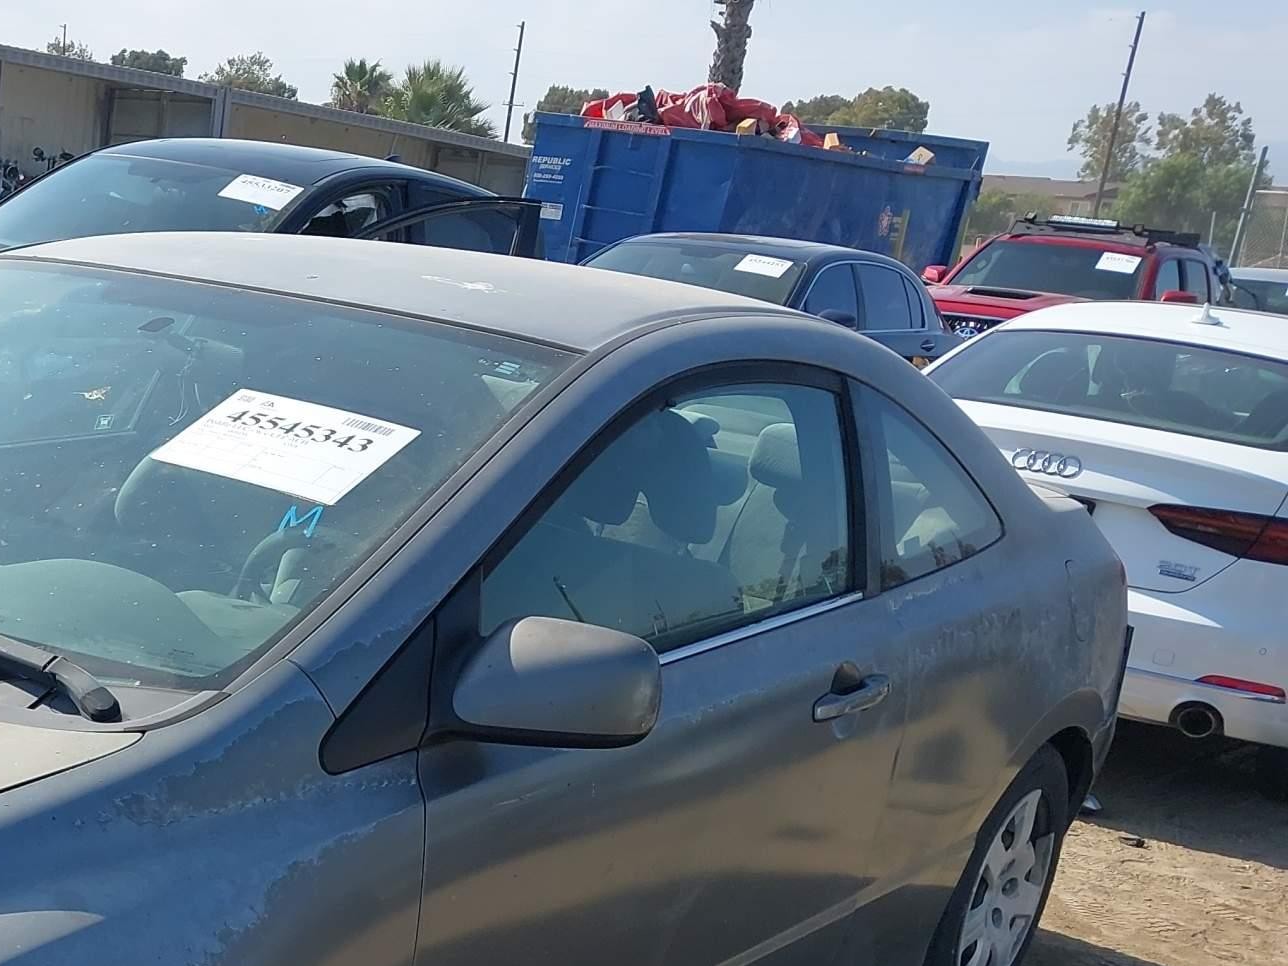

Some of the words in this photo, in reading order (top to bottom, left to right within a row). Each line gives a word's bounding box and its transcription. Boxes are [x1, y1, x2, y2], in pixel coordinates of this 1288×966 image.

[532, 155, 572, 166] REPUBLIC
[227, 409, 374, 453] 45545343
[277, 504, 324, 538] M
